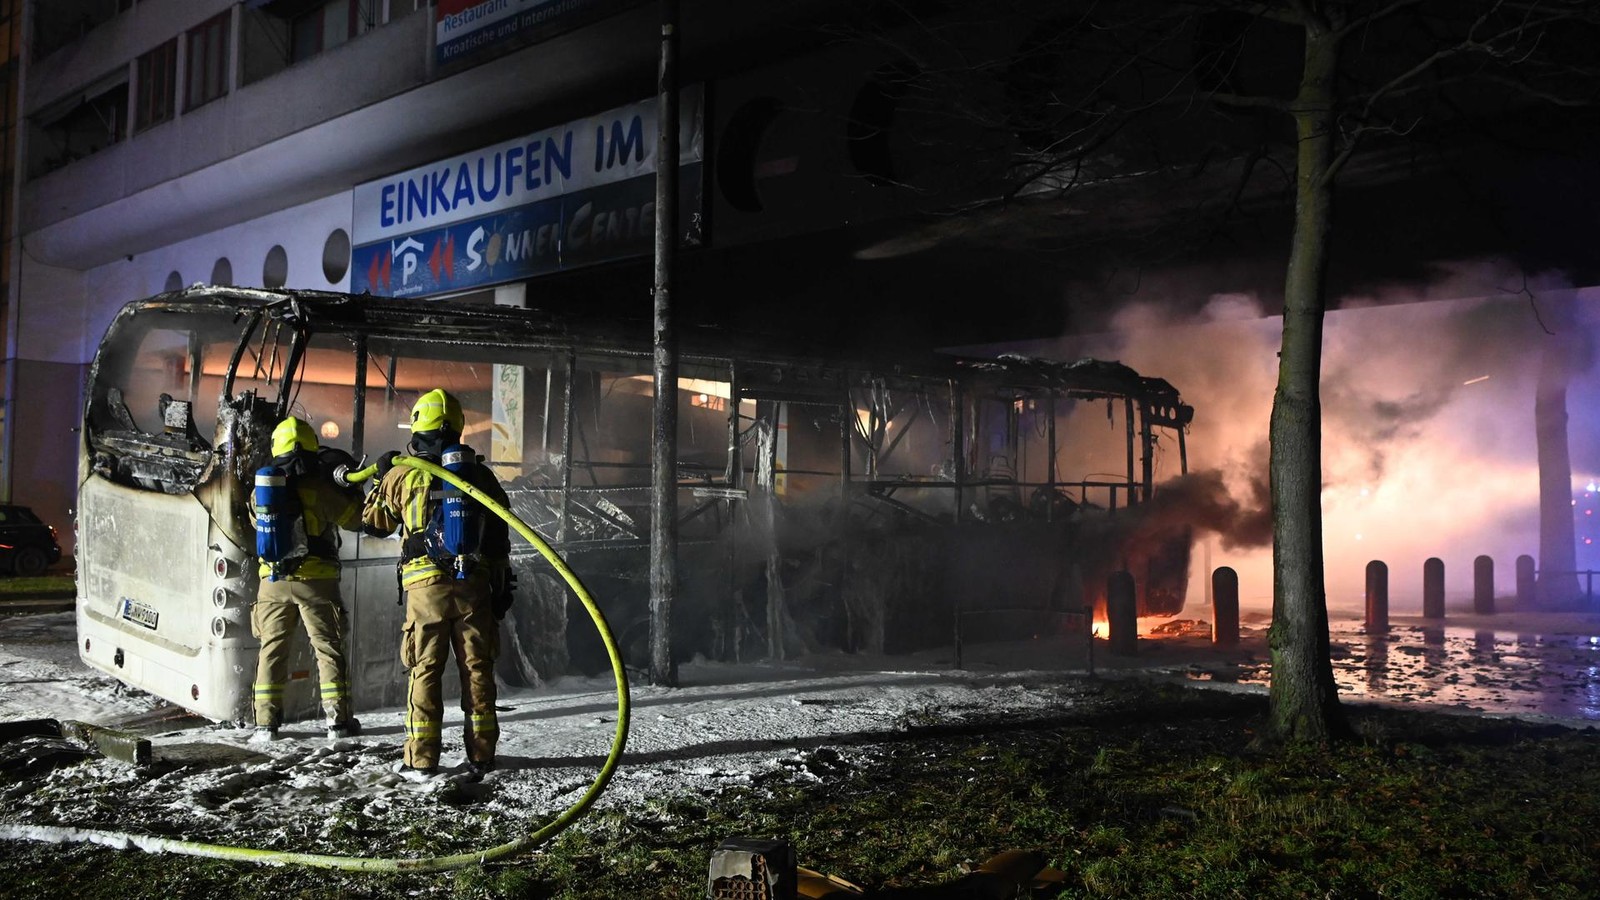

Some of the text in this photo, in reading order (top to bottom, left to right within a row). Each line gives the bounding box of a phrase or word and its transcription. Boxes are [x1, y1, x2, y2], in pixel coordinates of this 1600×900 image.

[443, 0, 584, 59] Kroatische und Internation
[381, 115, 644, 228] EINKAUFEN IM
[403, 252, 418, 286] P
[449, 510, 461, 518] 300
